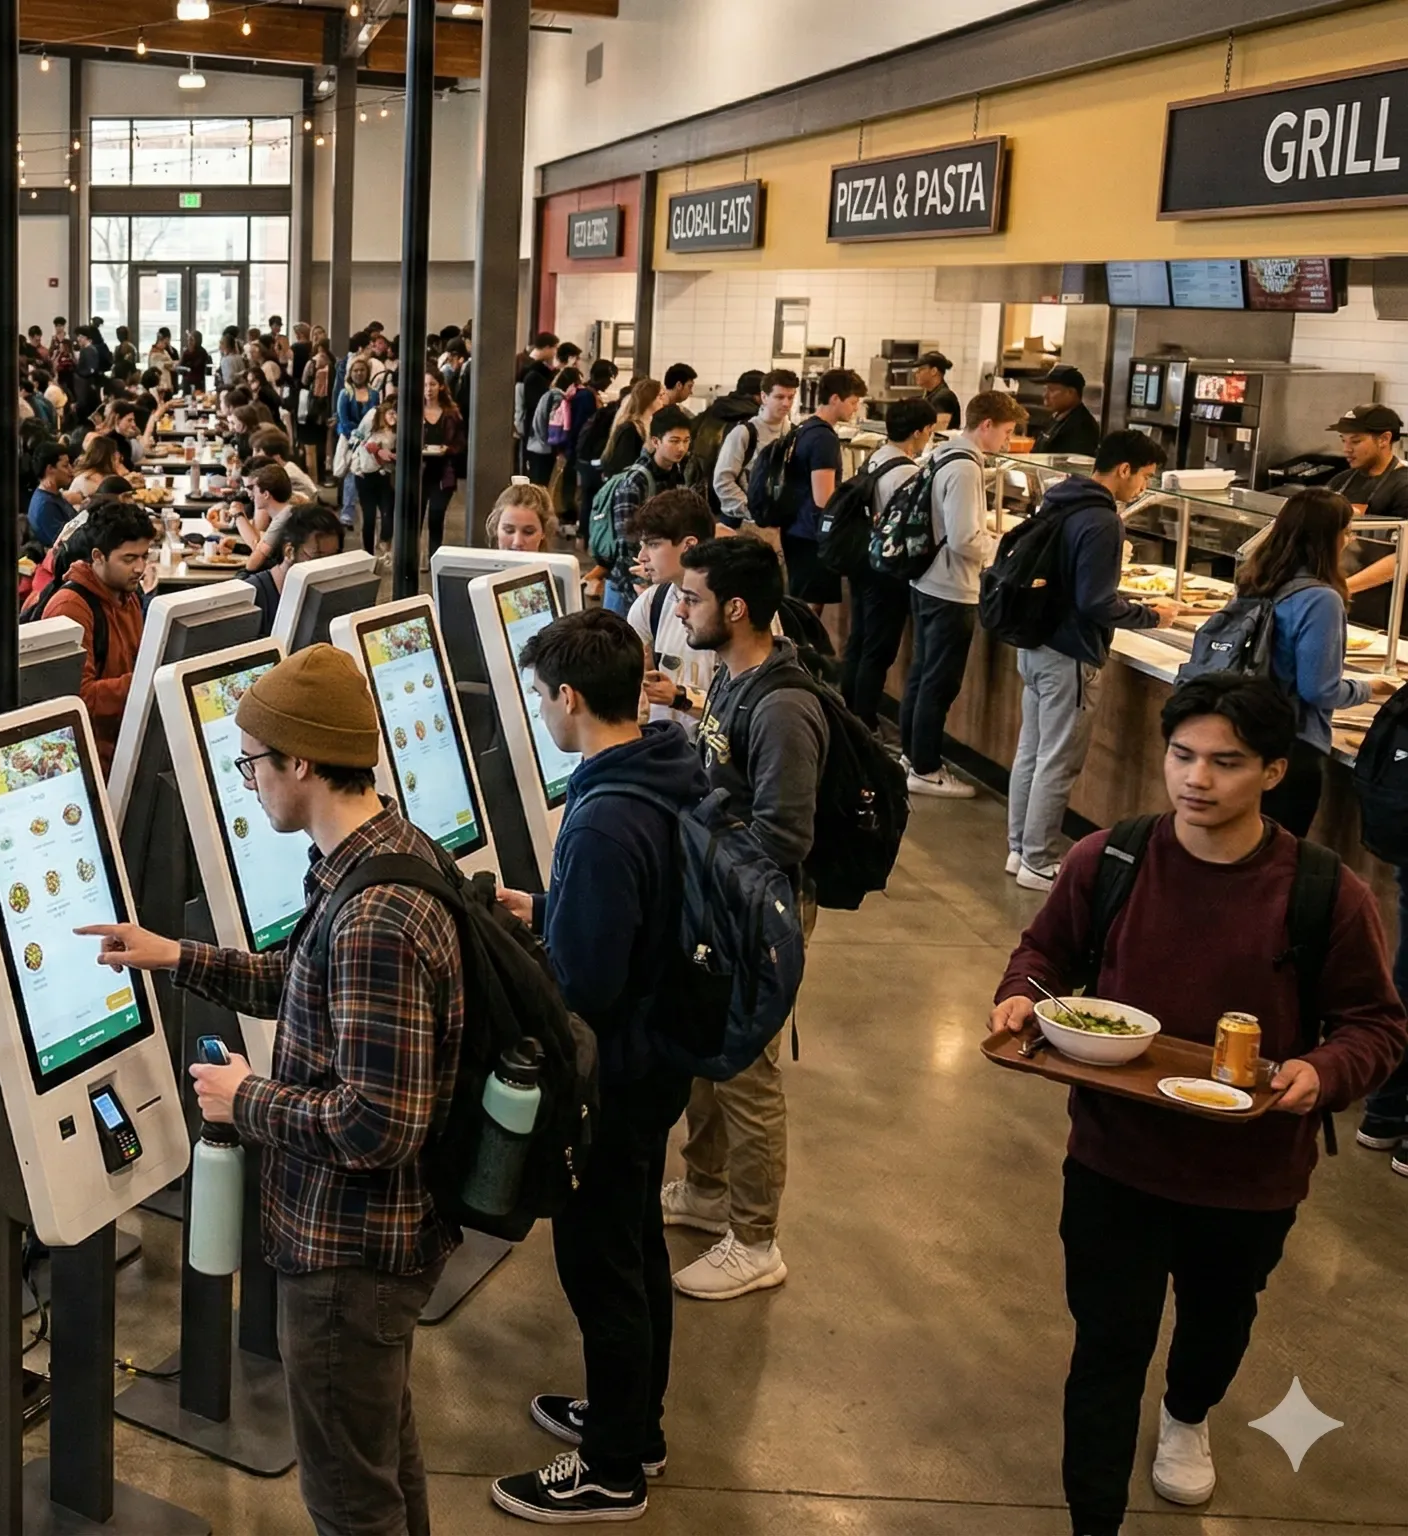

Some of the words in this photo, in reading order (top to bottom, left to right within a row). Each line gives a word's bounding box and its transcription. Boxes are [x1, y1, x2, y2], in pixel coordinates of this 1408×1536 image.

[1263, 96, 1401, 184] GRILL
[673, 201, 717, 239] GLOBAL
[719, 194, 752, 234] EATS
[835, 175, 888, 223] PIZZA
[893, 172, 909, 219] &
[913, 161, 986, 217] PASTA
